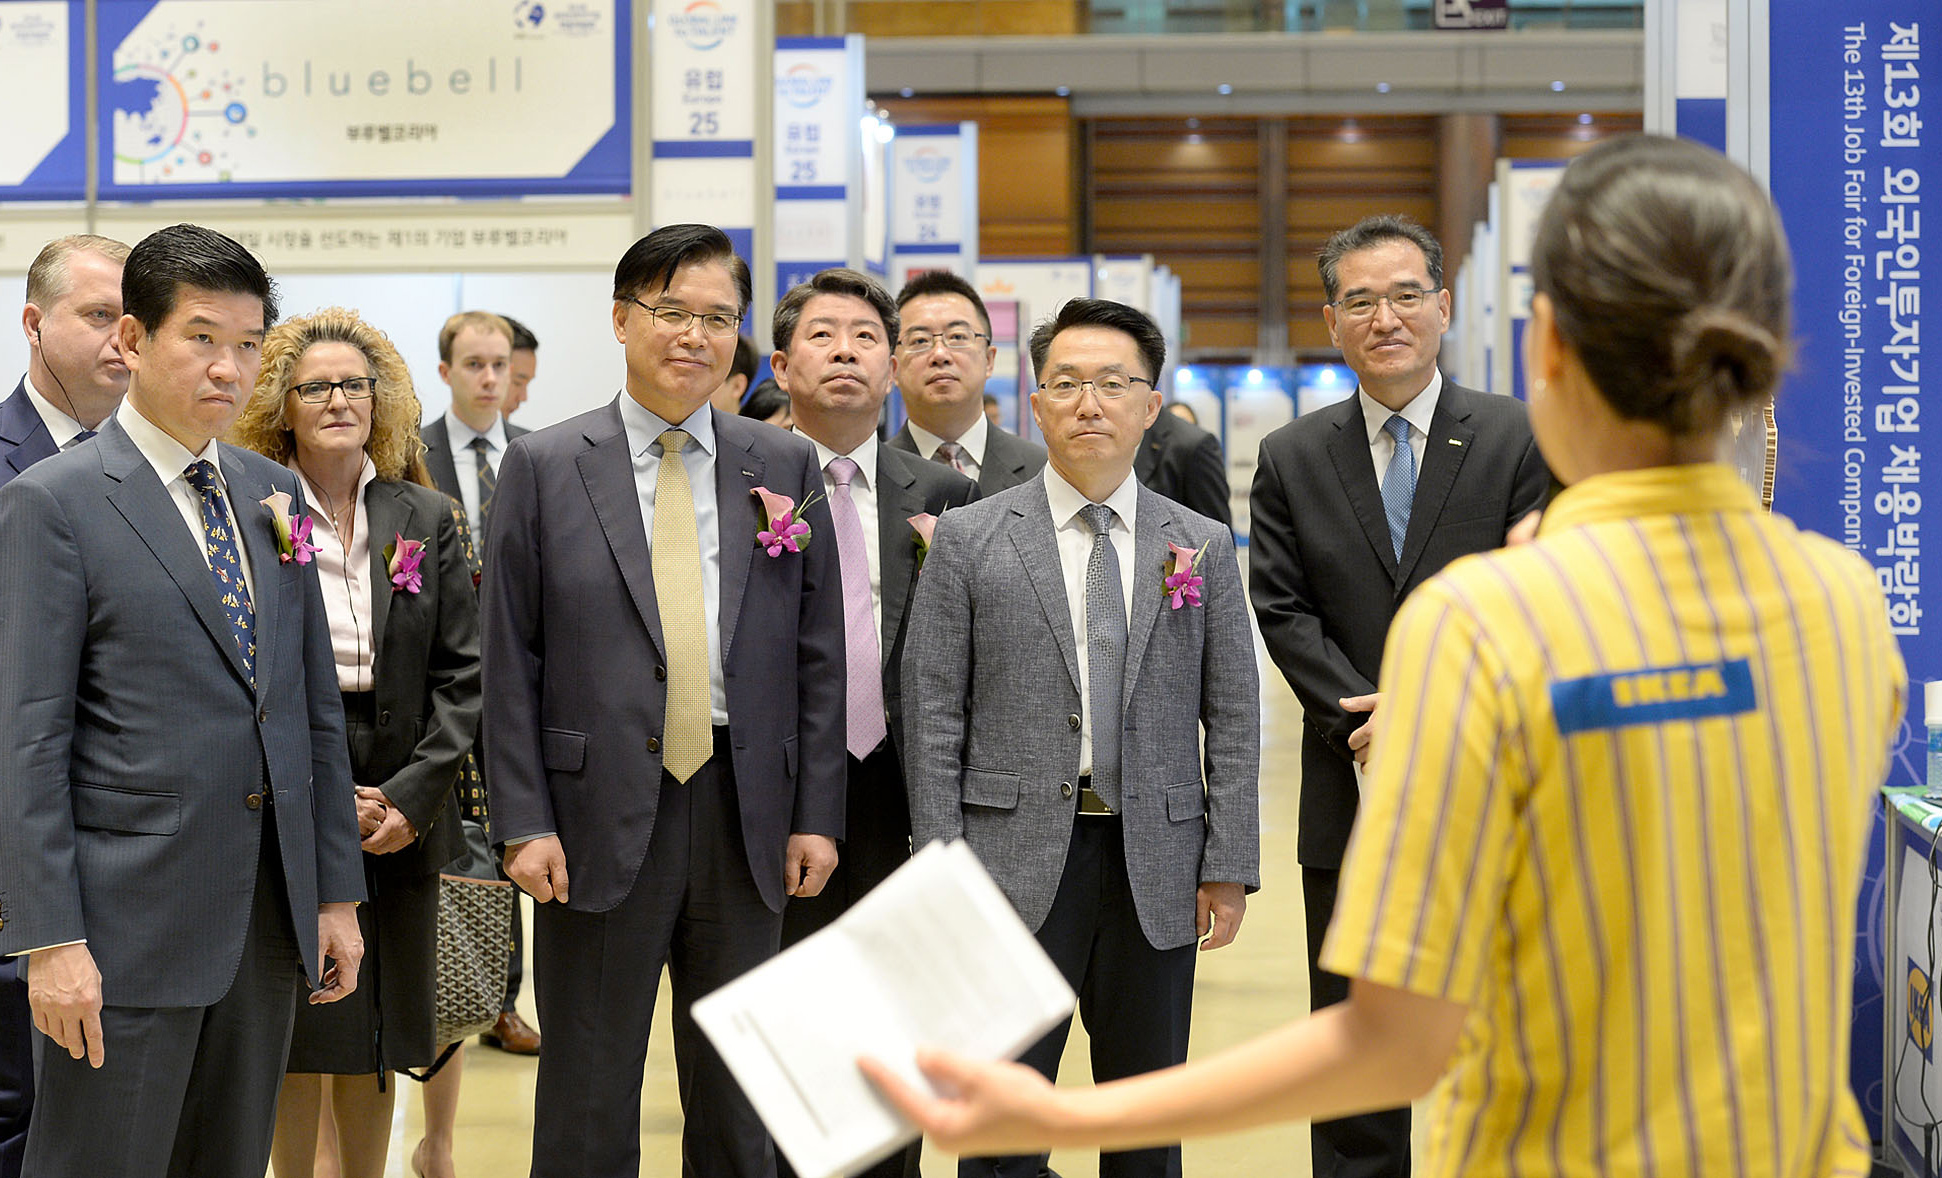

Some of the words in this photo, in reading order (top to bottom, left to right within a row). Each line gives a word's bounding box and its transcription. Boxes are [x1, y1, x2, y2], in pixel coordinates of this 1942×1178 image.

[1844, 21, 1867, 64] The
[262, 56, 523, 98] bluebell
[1844, 69, 1867, 120] 13th
[1879, 21, 1922, 148] 제13회
[689, 111, 720, 136] 25
[1844, 123, 1867, 164] Job
[790, 160, 818, 182] 25
[1844, 169, 1867, 212] Fair
[1844, 215, 1867, 250] for
[1876, 166, 1921, 433] 외국인투자기업
[1838, 254, 1867, 442] Foreign-Invested
[1874, 444, 1923, 636] 채용박람회
[1611, 669, 1729, 708] IKEA
